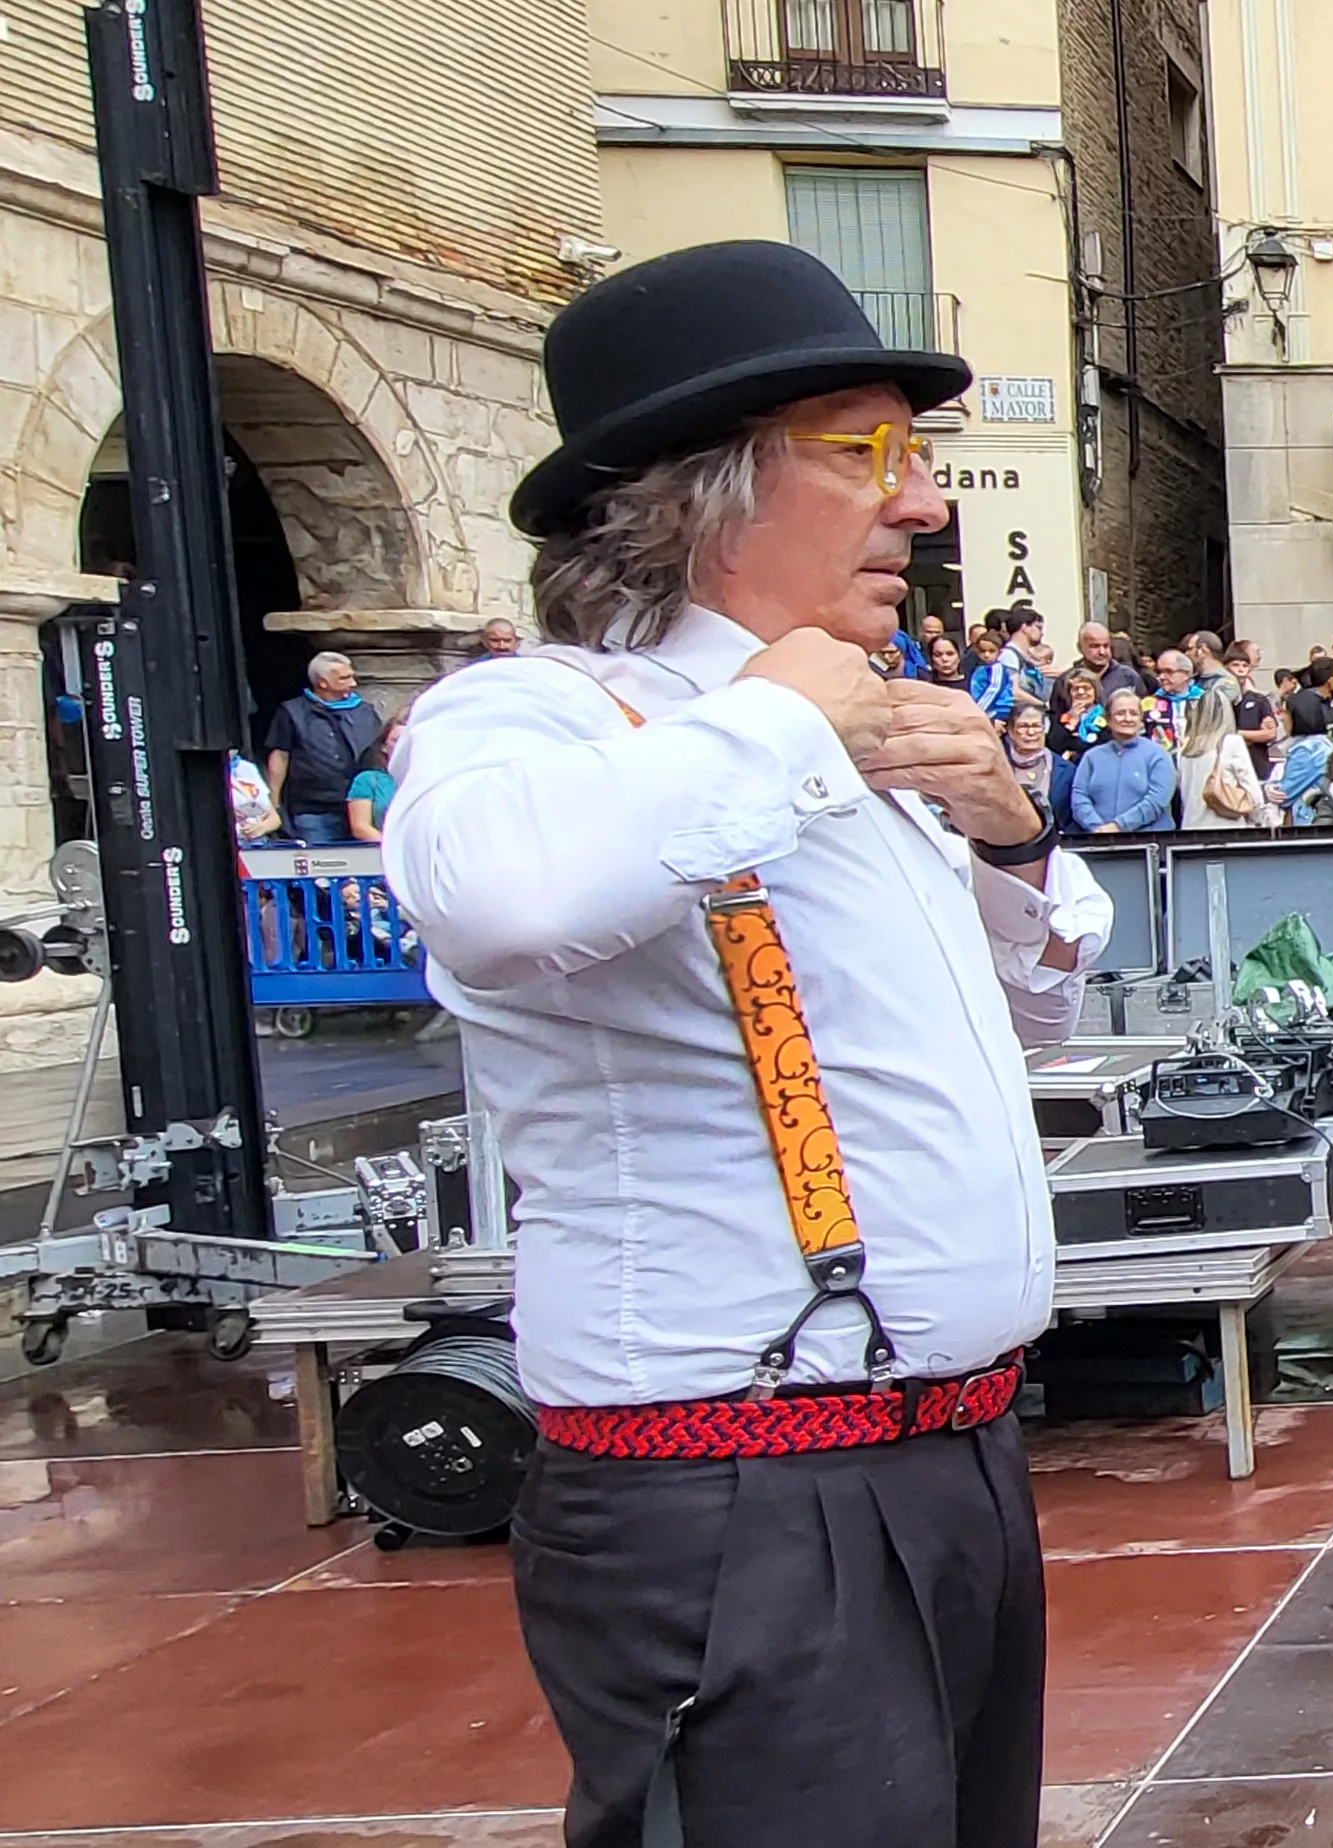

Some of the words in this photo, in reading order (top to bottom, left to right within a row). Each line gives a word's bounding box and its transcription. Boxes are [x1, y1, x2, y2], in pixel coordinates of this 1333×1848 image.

[990, 401, 1047, 416] MAYOR
[1007, 382, 1046, 398] CALLE
[127, 695, 146, 748] TOWER
[132, 748, 151, 798] SUPER
[163, 847, 190, 944] SOUNDER'S
